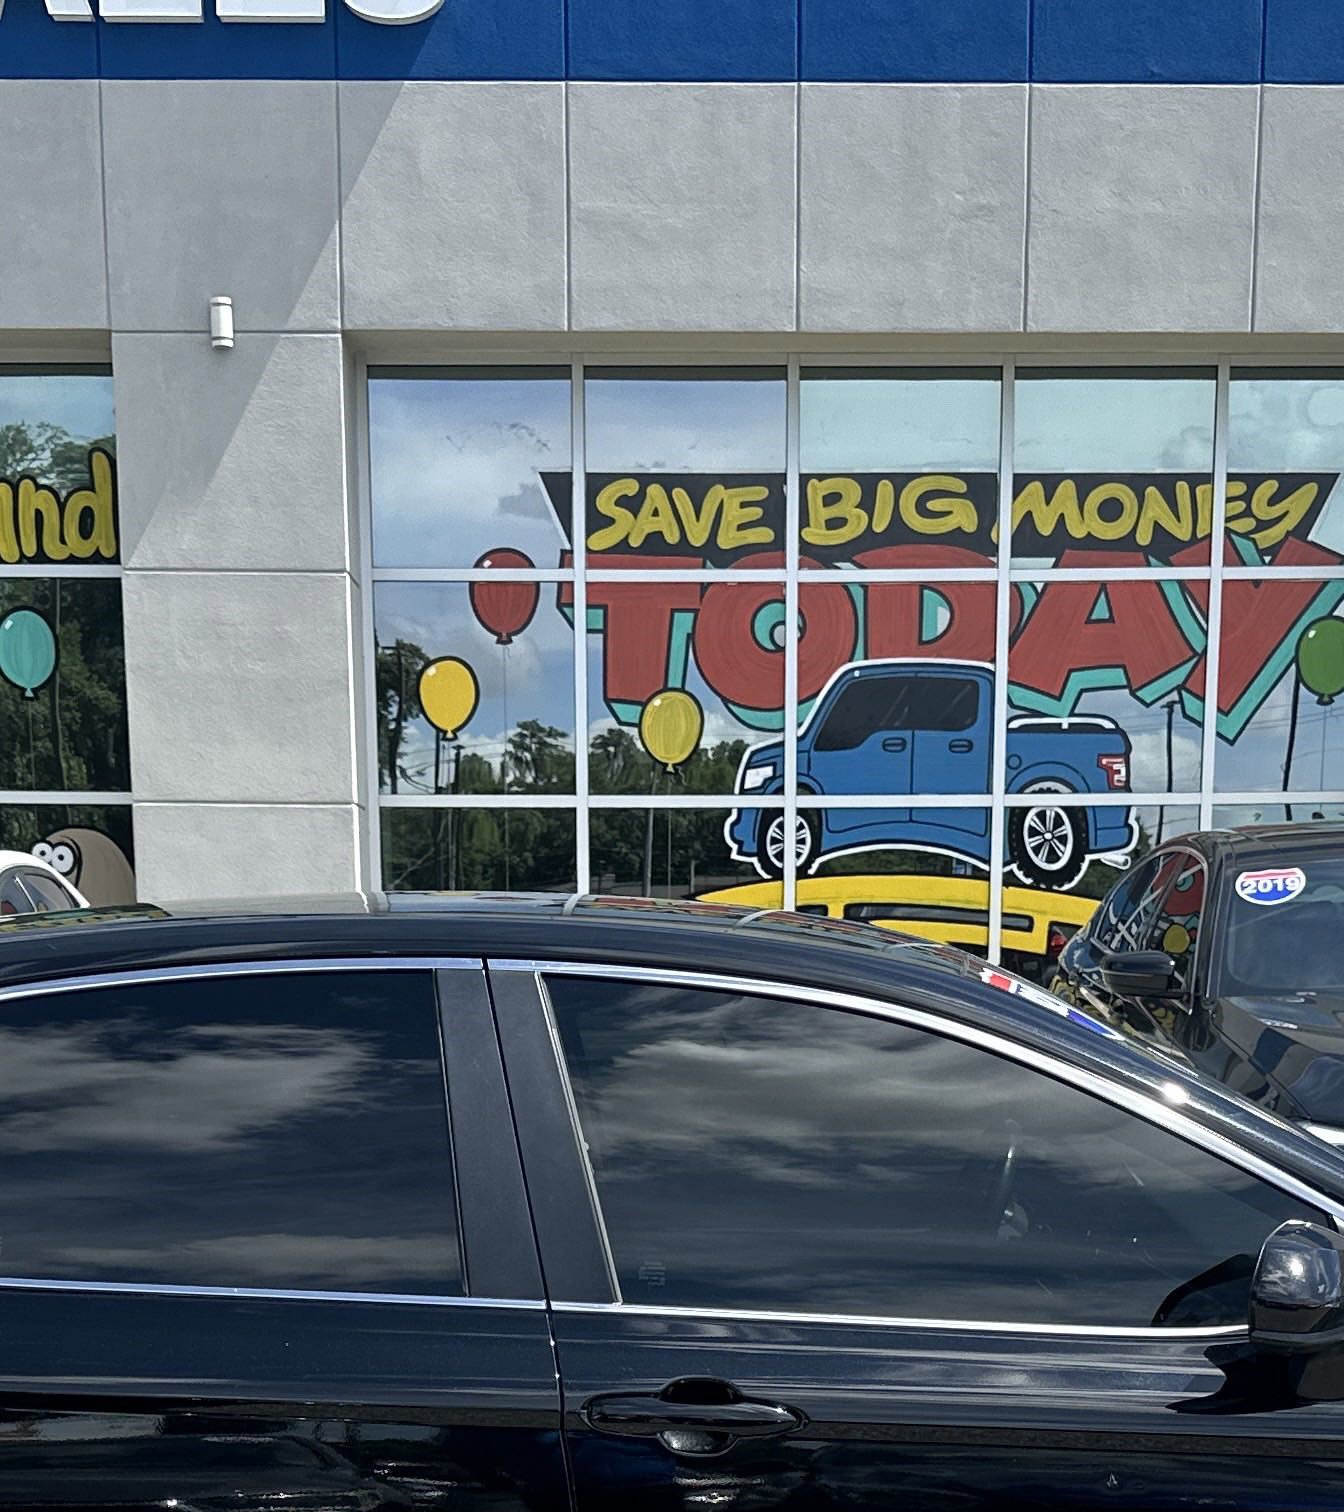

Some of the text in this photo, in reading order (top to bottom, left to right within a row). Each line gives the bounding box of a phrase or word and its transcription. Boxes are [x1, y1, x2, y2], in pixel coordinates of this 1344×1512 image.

[587, 474, 1320, 550] SAVE BIG MONEY
[1241, 876, 1302, 895] 2019
